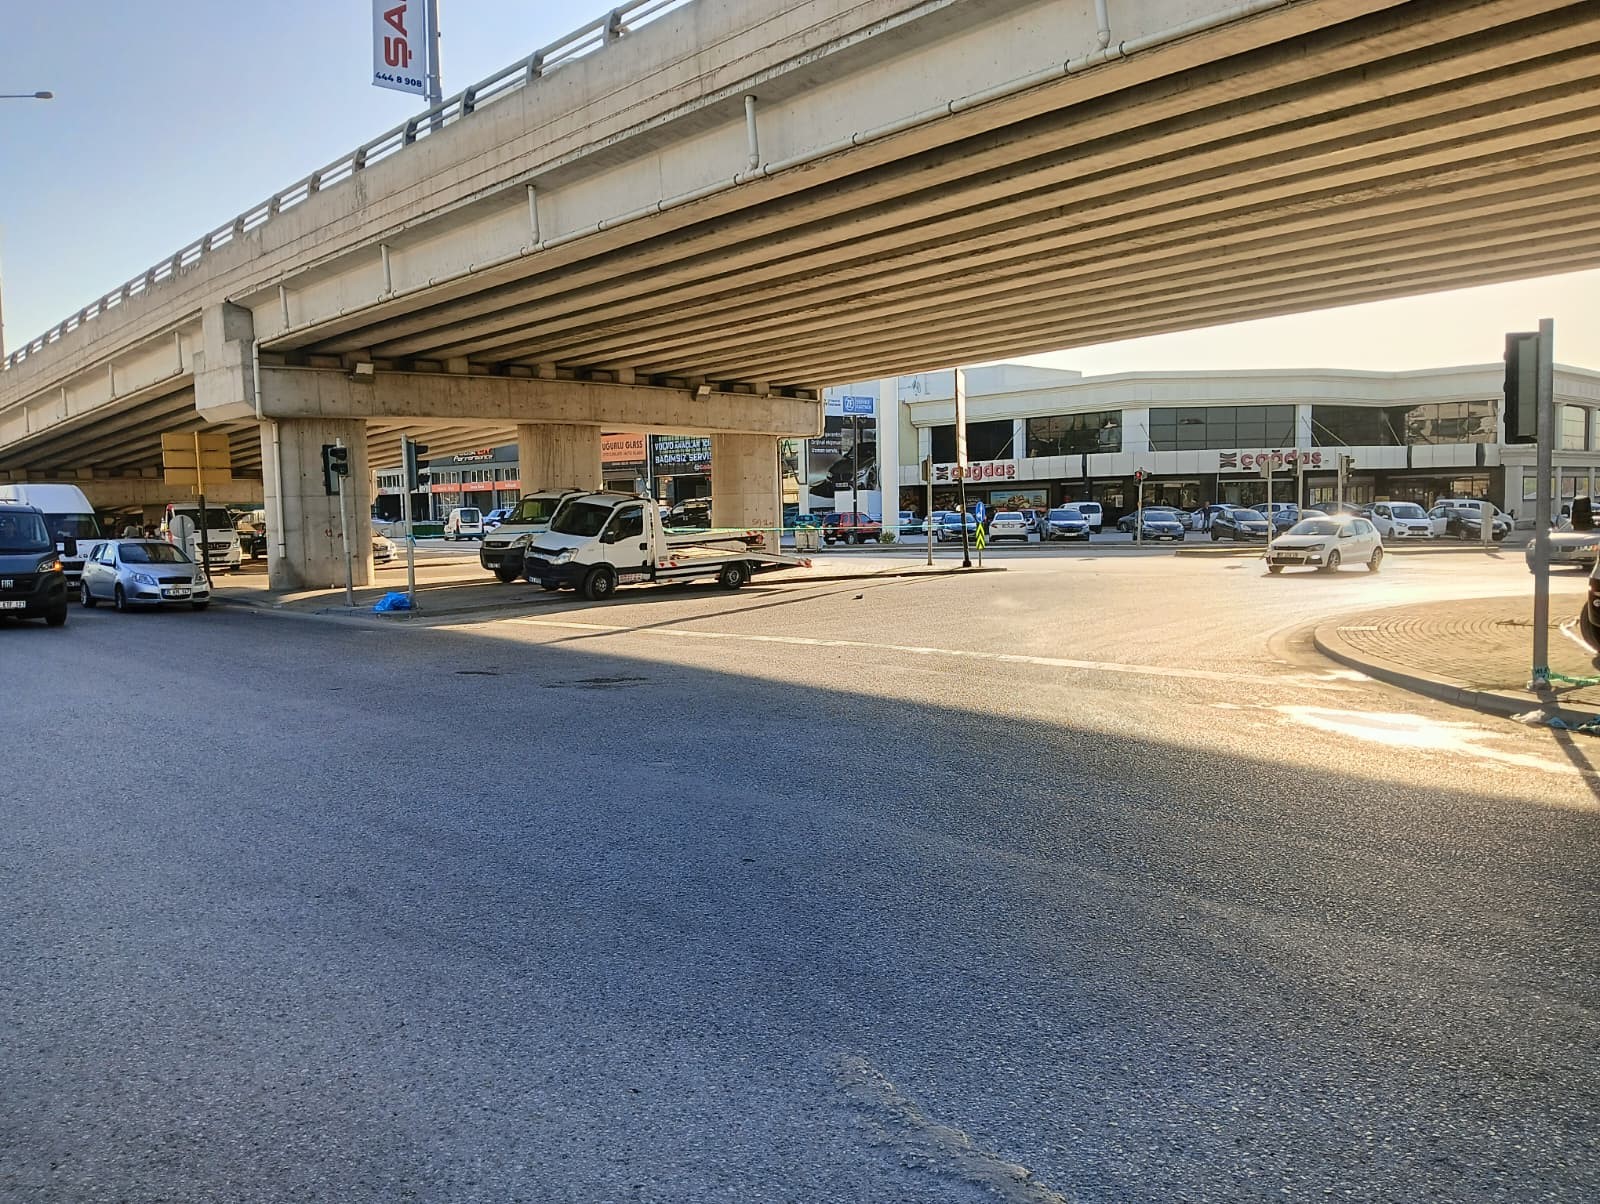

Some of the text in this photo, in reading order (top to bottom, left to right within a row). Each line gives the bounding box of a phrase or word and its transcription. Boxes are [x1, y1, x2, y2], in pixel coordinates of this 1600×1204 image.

[383, 0, 412, 68] ŞA
[376, 72, 422, 88] 444 8 908
[2, 580, 14, 588] FIAT
